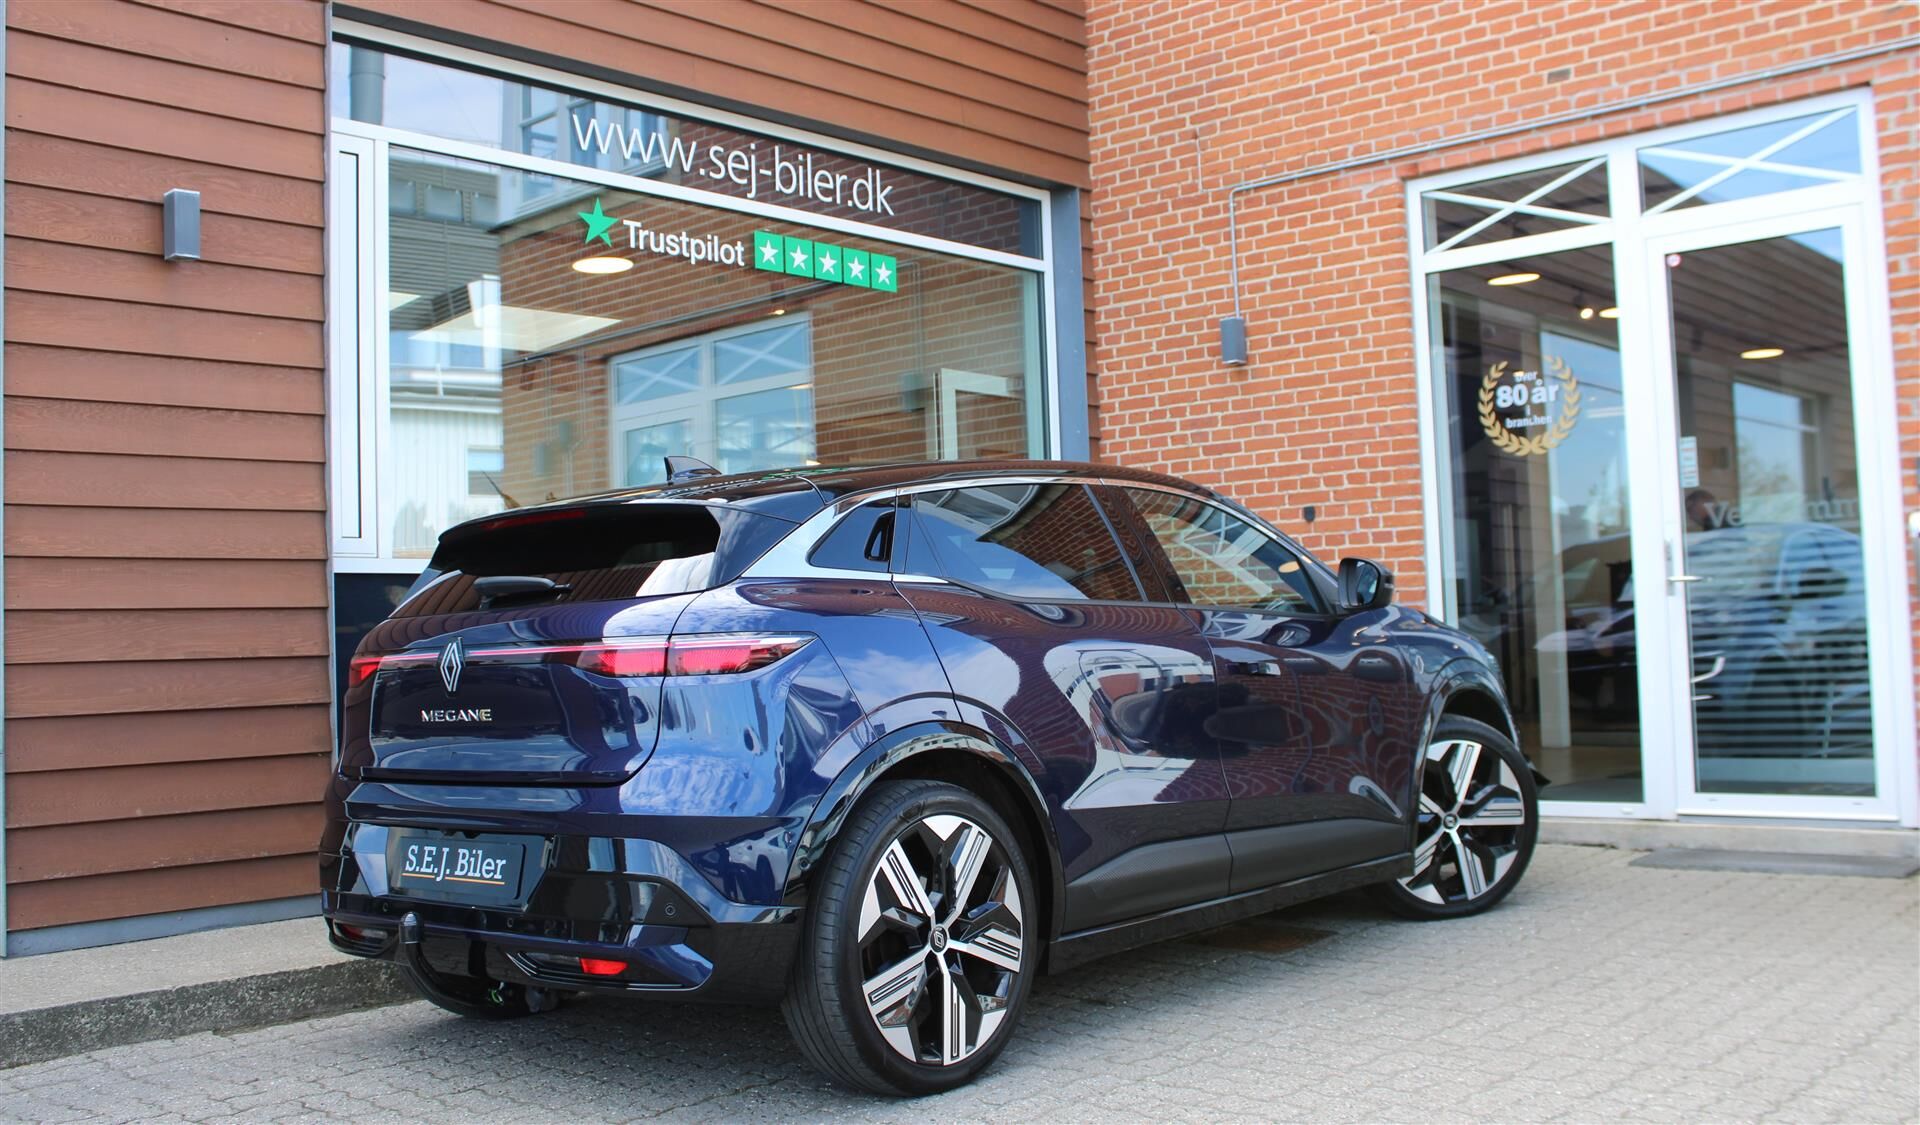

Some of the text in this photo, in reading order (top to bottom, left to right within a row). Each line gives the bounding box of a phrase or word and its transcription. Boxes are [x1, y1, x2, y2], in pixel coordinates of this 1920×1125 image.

[573, 113, 894, 215] www.sej-biler.dk
[623, 219, 745, 266] Trustpilot
[1496, 380, 1559, 408] 80 år
[421, 708, 492, 722] MEGANE
[405, 844, 507, 882] S.E.J. Biler
